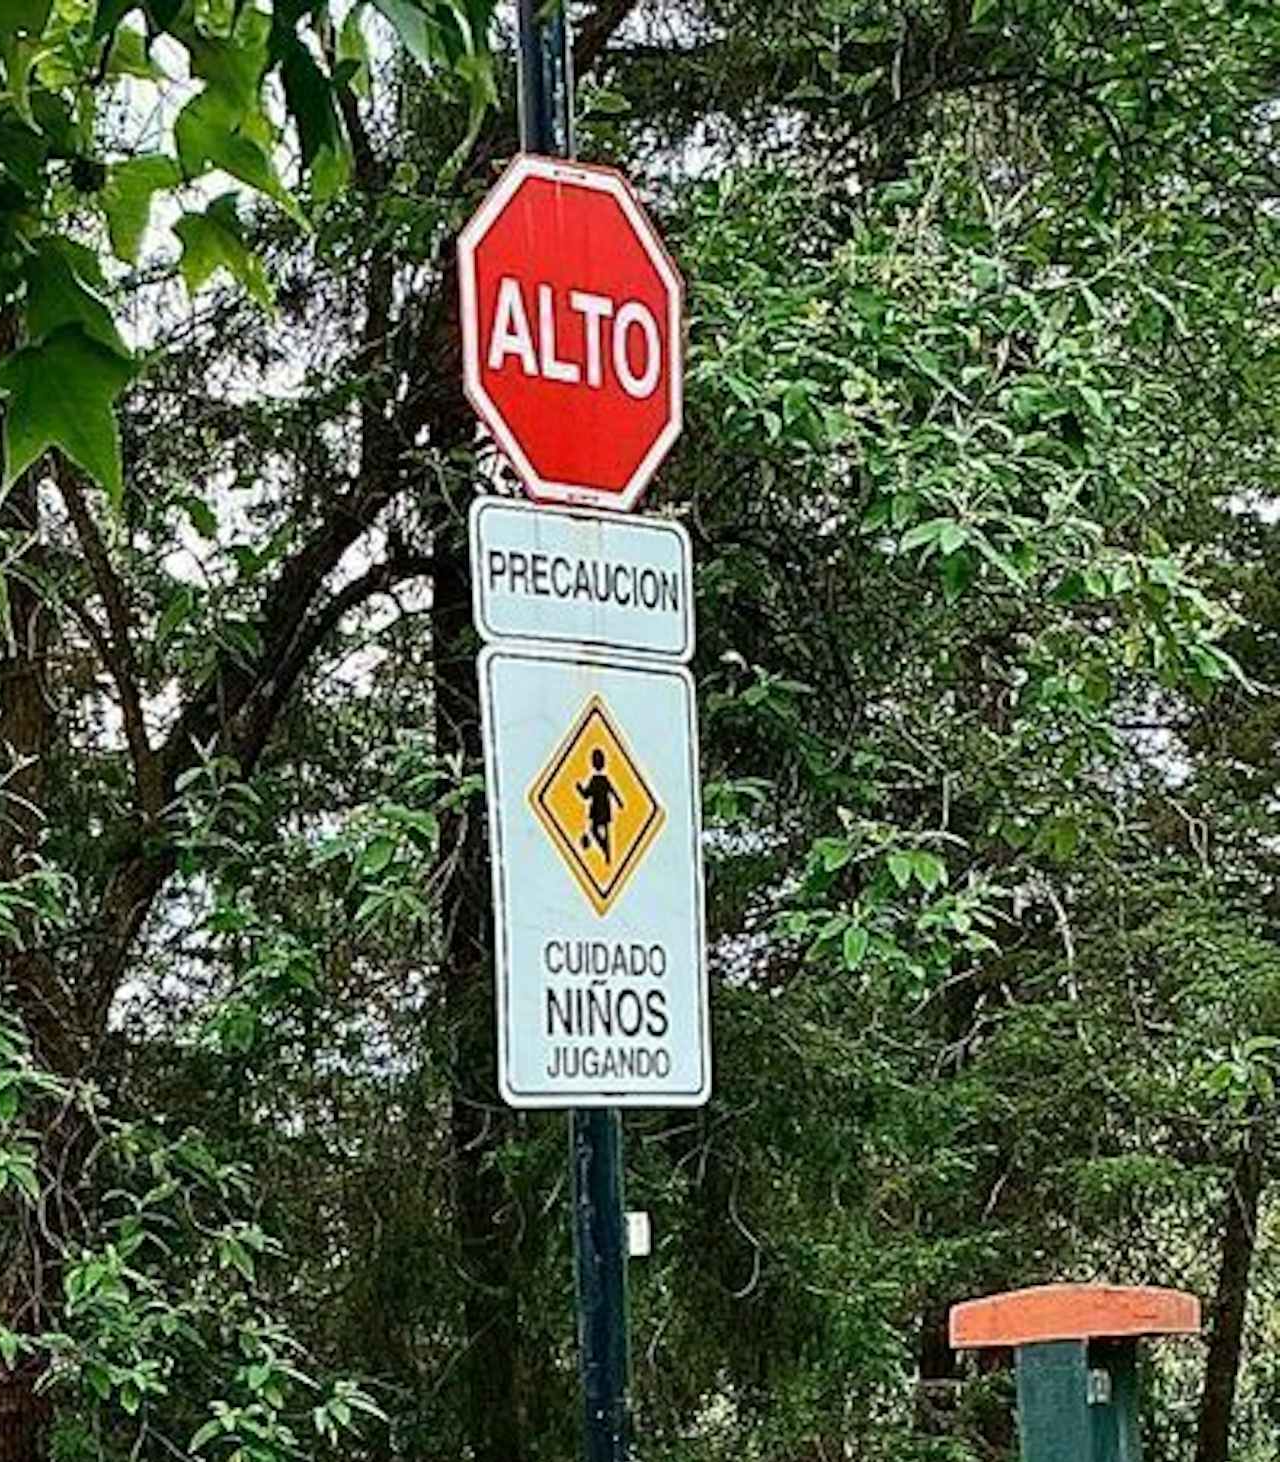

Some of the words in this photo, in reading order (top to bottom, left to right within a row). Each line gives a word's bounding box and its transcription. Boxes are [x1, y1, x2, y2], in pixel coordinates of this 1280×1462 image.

[487, 276, 661, 398] ALTO
[488, 549, 679, 612] PRECAUCION
[545, 941, 667, 977] CUIDADO
[546, 980, 669, 1037] NIÑOS
[546, 1046, 671, 1079] JUGANDO
